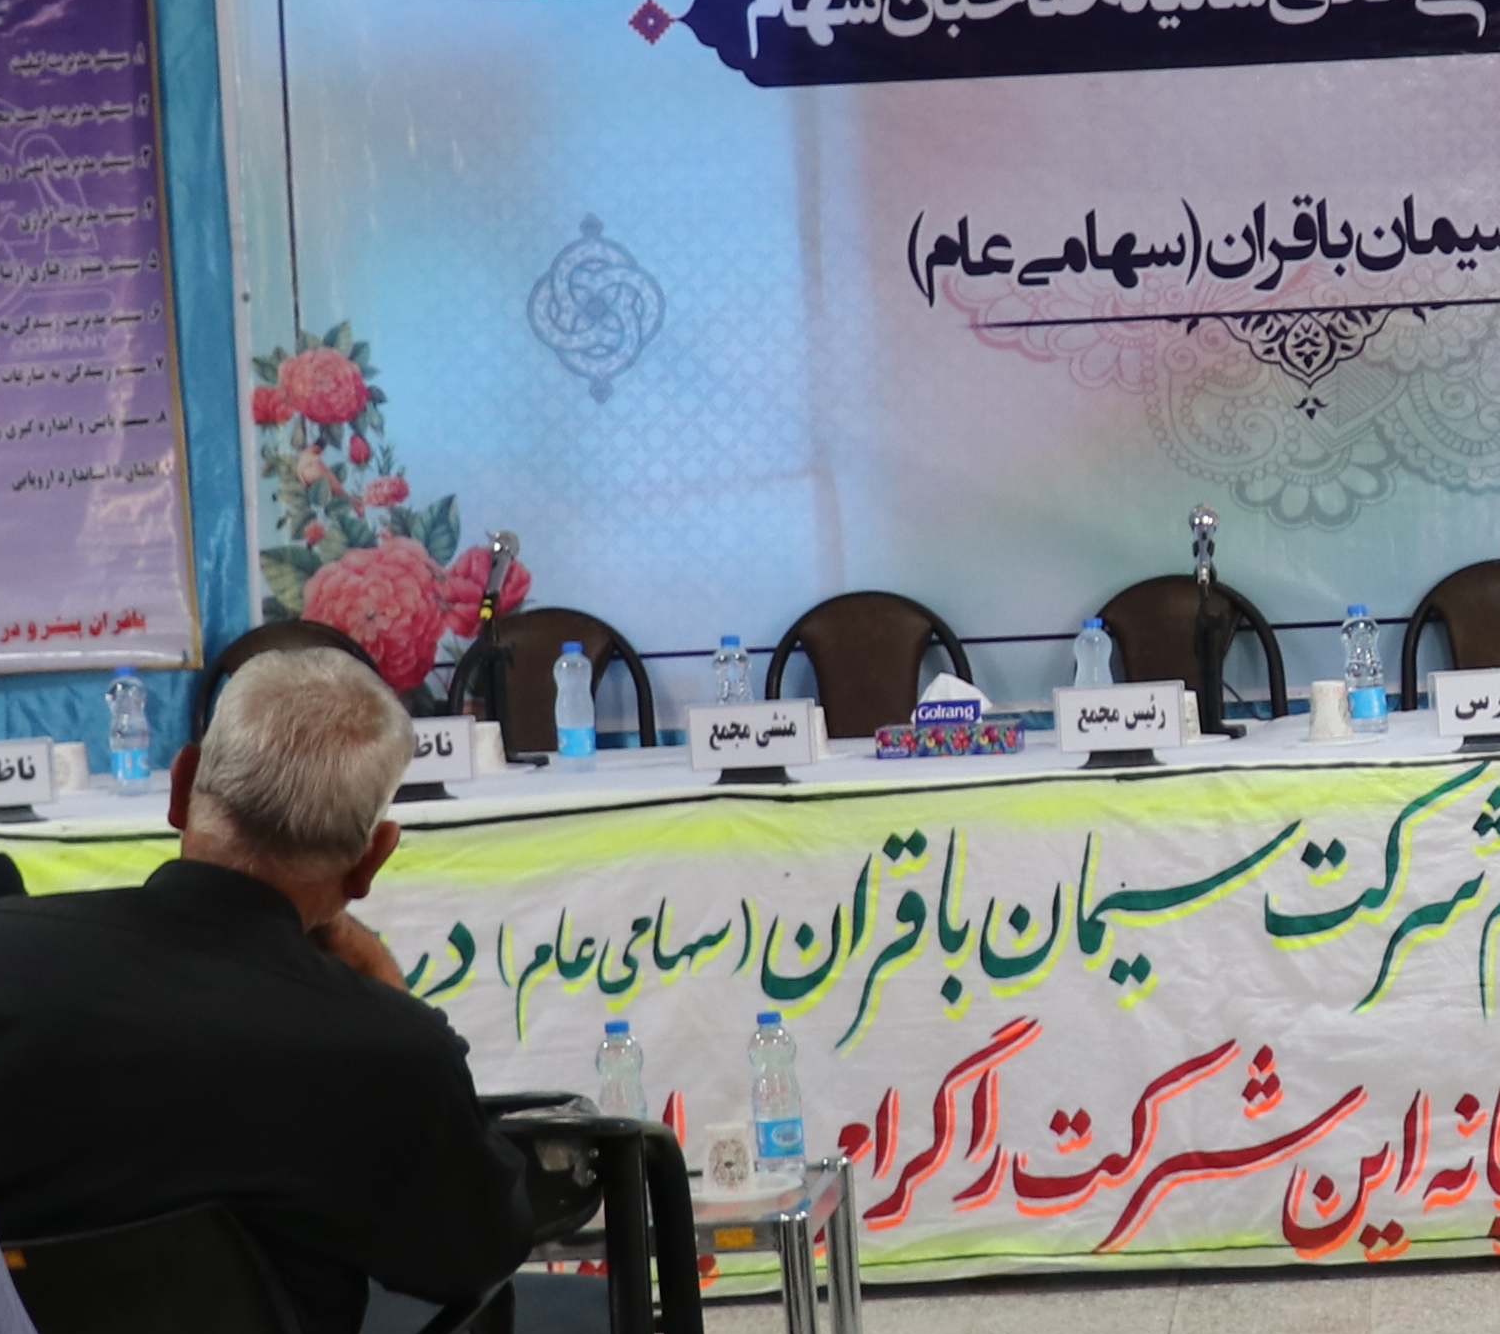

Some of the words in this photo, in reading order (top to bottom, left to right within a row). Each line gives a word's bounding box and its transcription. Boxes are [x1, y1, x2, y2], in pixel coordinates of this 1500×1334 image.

[907, 209, 1015, 308] عام)
[1016, 197, 1202, 289] (سهامی
[1205, 194, 1355, 291] باقران
[0, 623, 21, 644] در
[88, 609, 146, 638] باقران
[755, 710, 797, 747] منشی
[917, 703, 975, 721] Golrang
[1077, 703, 1121, 734] مجمع
[1124, 694, 1167, 729] رئیس
[414, 730, 454, 759] ناظ
[708, 722, 752, 751] مجمع
[979, 817, 1304, 987] سیمان
[760, 827, 972, 1054] باقران
[1012, 1037, 1366, 1255] شرکت
[1282, 1088, 1427, 1257] این
